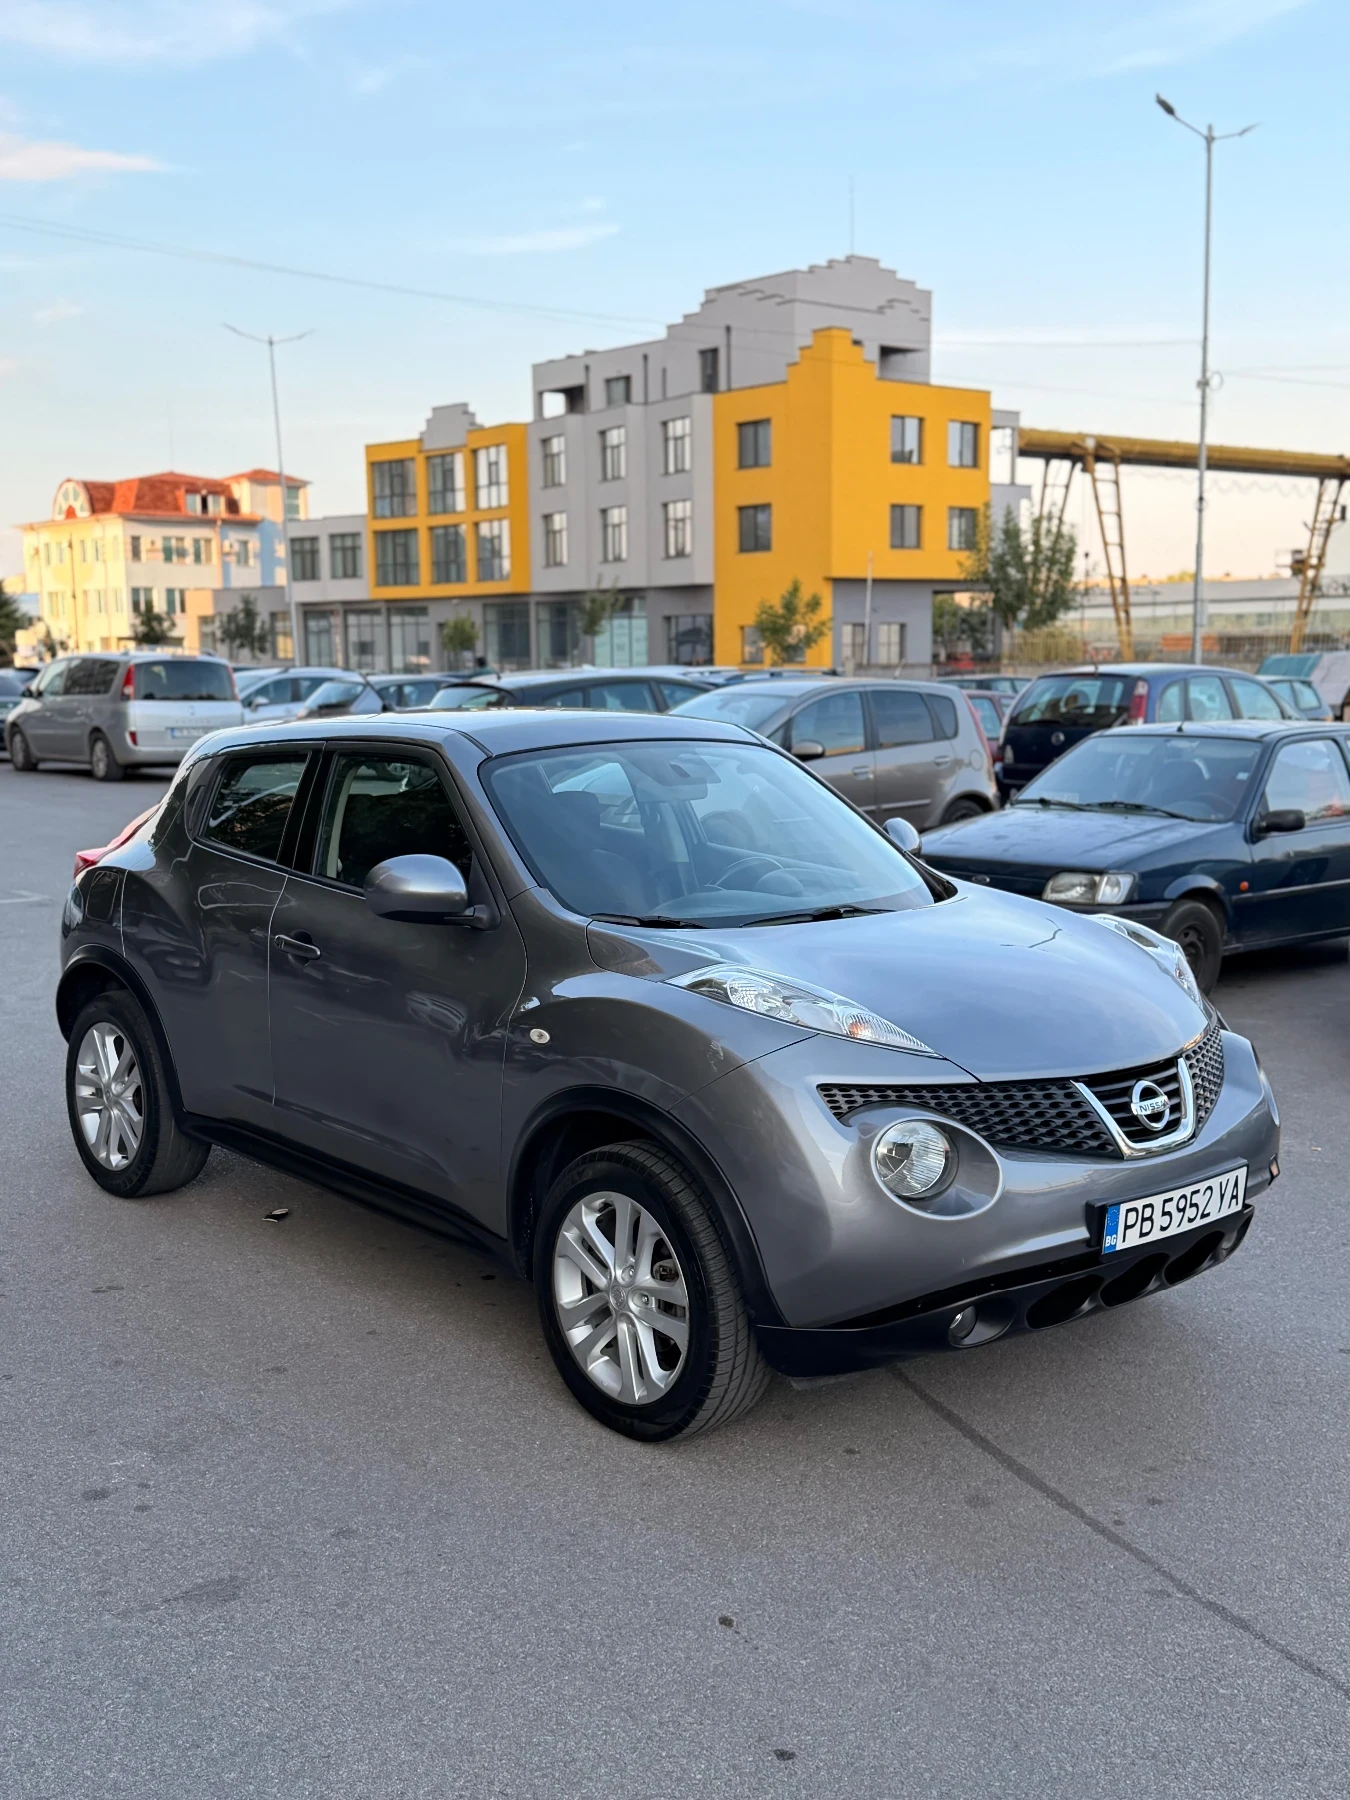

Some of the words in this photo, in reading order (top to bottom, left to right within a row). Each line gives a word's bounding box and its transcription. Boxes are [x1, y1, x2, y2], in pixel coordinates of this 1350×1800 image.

[1122, 1203, 1155, 1243] PB
[1160, 1185, 1213, 1231] 5952
[1218, 1174, 1239, 1213] YA
[1104, 1234, 1117, 1248] BG
